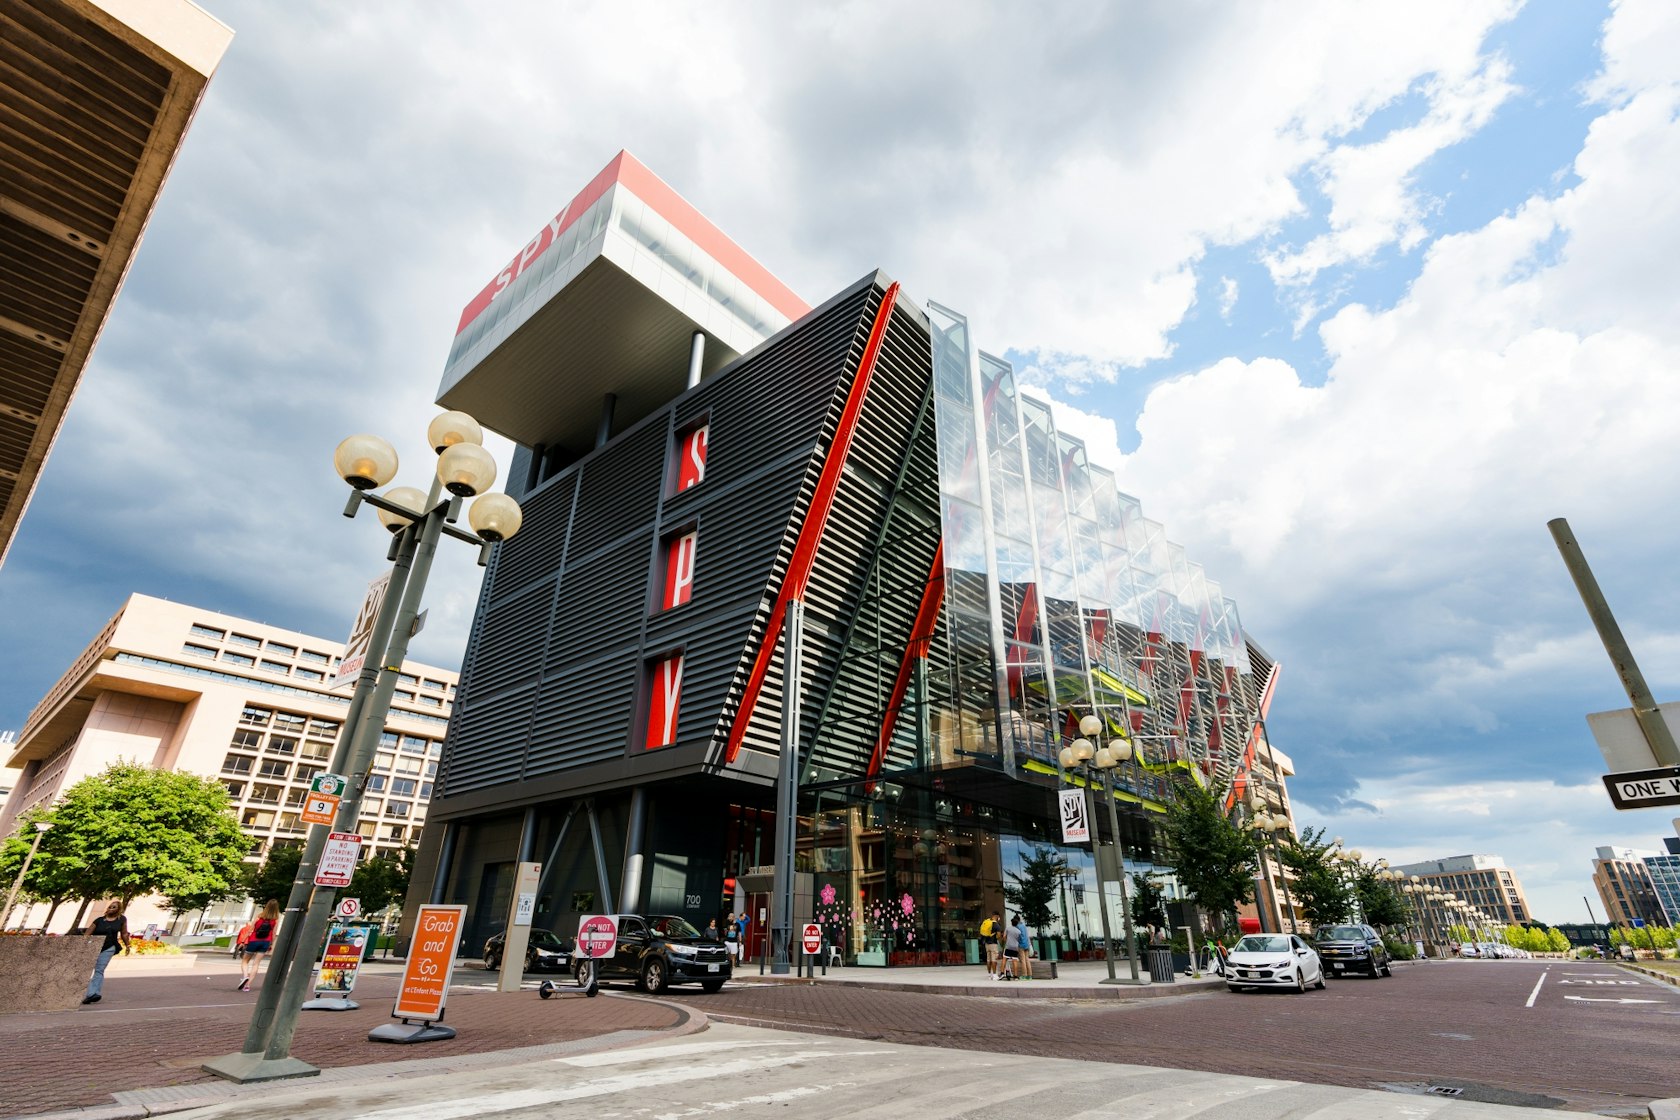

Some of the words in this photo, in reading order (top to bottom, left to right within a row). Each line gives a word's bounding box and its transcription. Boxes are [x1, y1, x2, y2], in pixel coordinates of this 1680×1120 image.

[491, 200, 573, 300] SPY
[1623, 780, 1666, 797] ONE
[317, 803, 325, 811] 9
[1063, 796, 1082, 819] SPY
[686, 895, 701, 904] 700
[424, 915, 454, 932] Grab
[598, 923, 611, 931] NOT
[423, 936, 447, 952] and
[420, 958, 438, 975] Go
